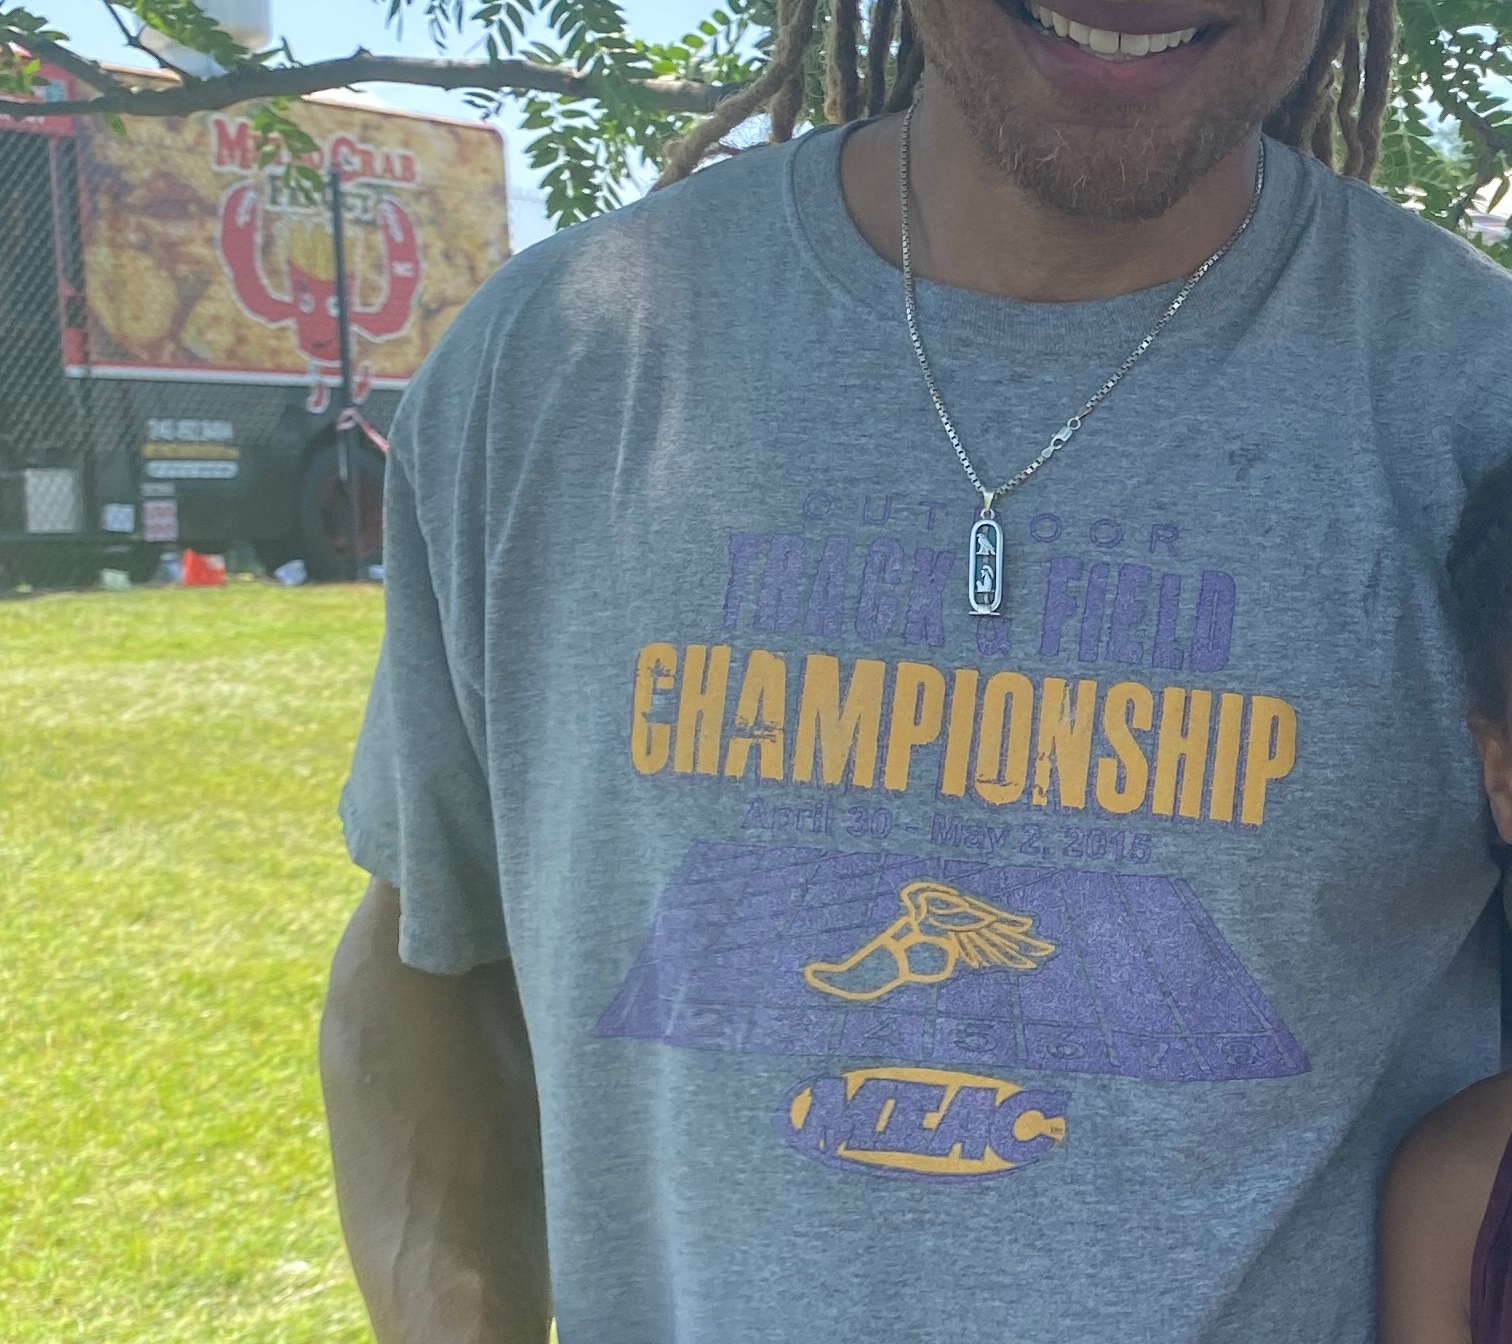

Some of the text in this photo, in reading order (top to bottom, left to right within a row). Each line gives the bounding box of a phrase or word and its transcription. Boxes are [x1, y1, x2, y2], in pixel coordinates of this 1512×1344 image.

[721, 532, 956, 648] TRACK
[1039, 558, 1237, 673] FIELD
[631, 641, 1298, 828] CHAMPIONSHIP
[847, 804, 894, 839] 30
[930, 813, 1009, 856] May
